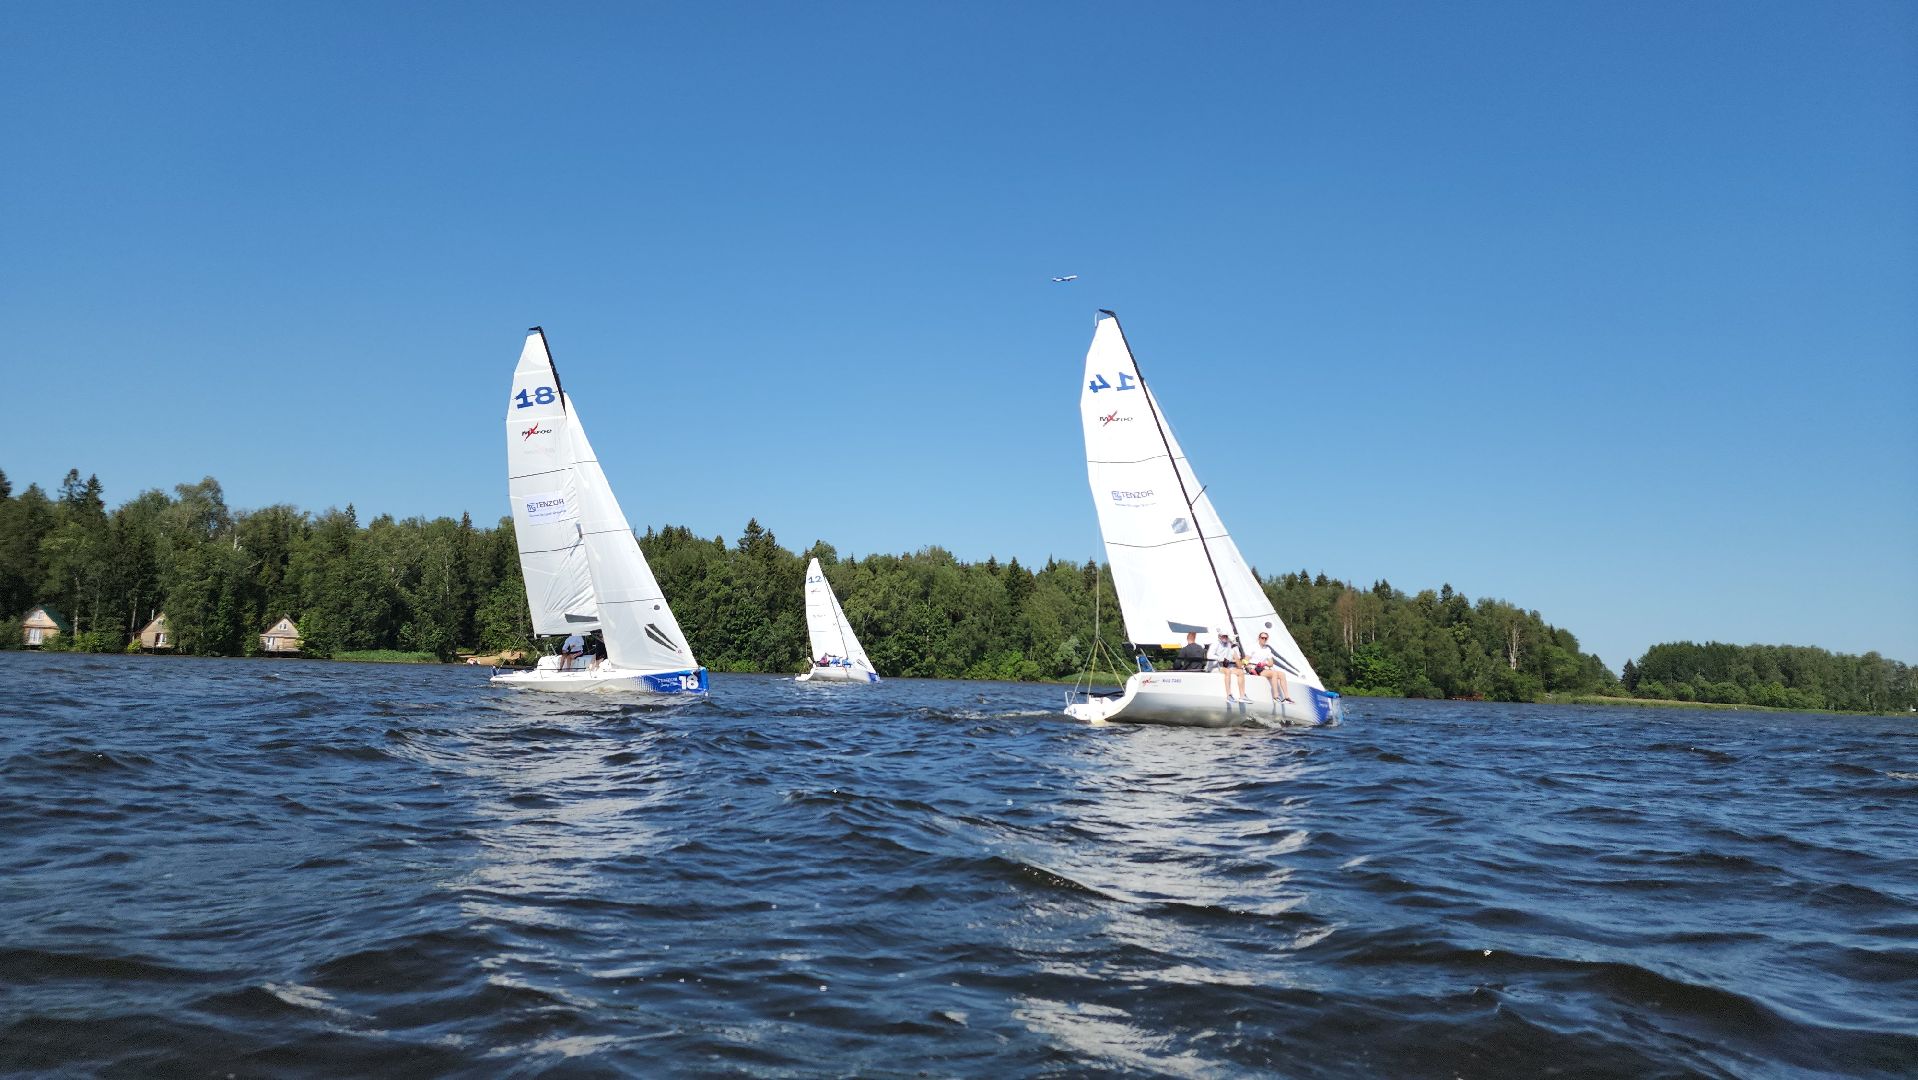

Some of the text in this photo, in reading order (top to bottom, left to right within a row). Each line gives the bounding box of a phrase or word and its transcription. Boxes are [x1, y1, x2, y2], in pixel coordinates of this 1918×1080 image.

[516, 386, 556, 409] 18
[535, 498, 565, 509] TENZOR
[808, 575, 822, 584] 12
[678, 675, 699, 690] 18
